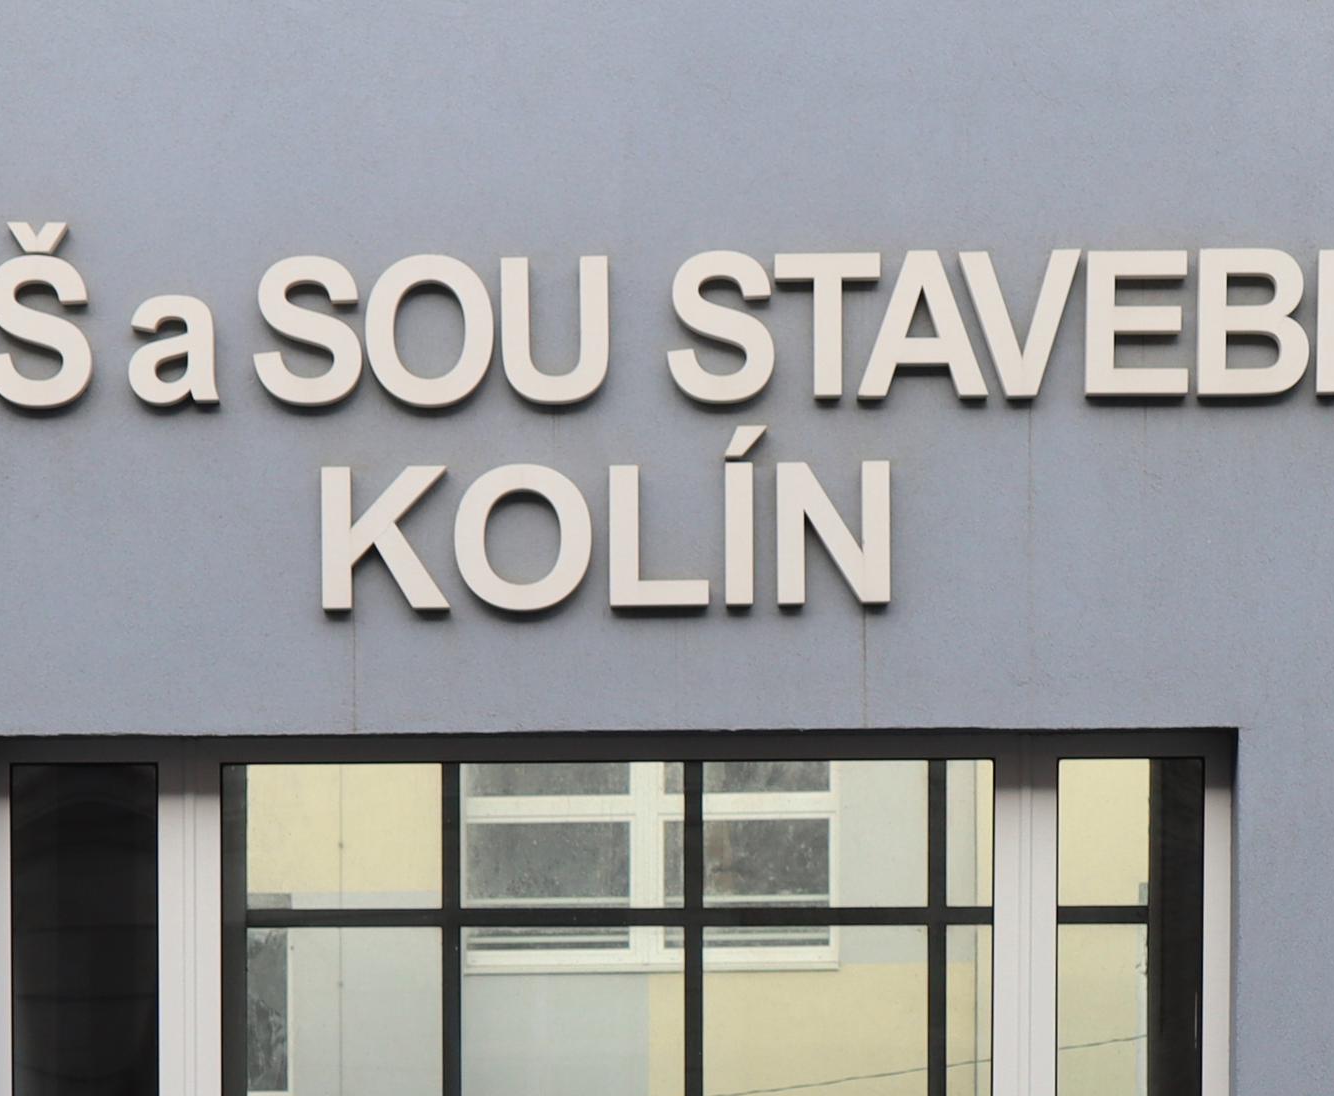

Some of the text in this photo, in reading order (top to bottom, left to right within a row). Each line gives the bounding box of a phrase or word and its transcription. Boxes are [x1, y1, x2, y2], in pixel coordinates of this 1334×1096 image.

[128, 294, 220, 407] a
[253, 253, 609, 408] SOU
[320, 425, 892, 613] KOLÍN
